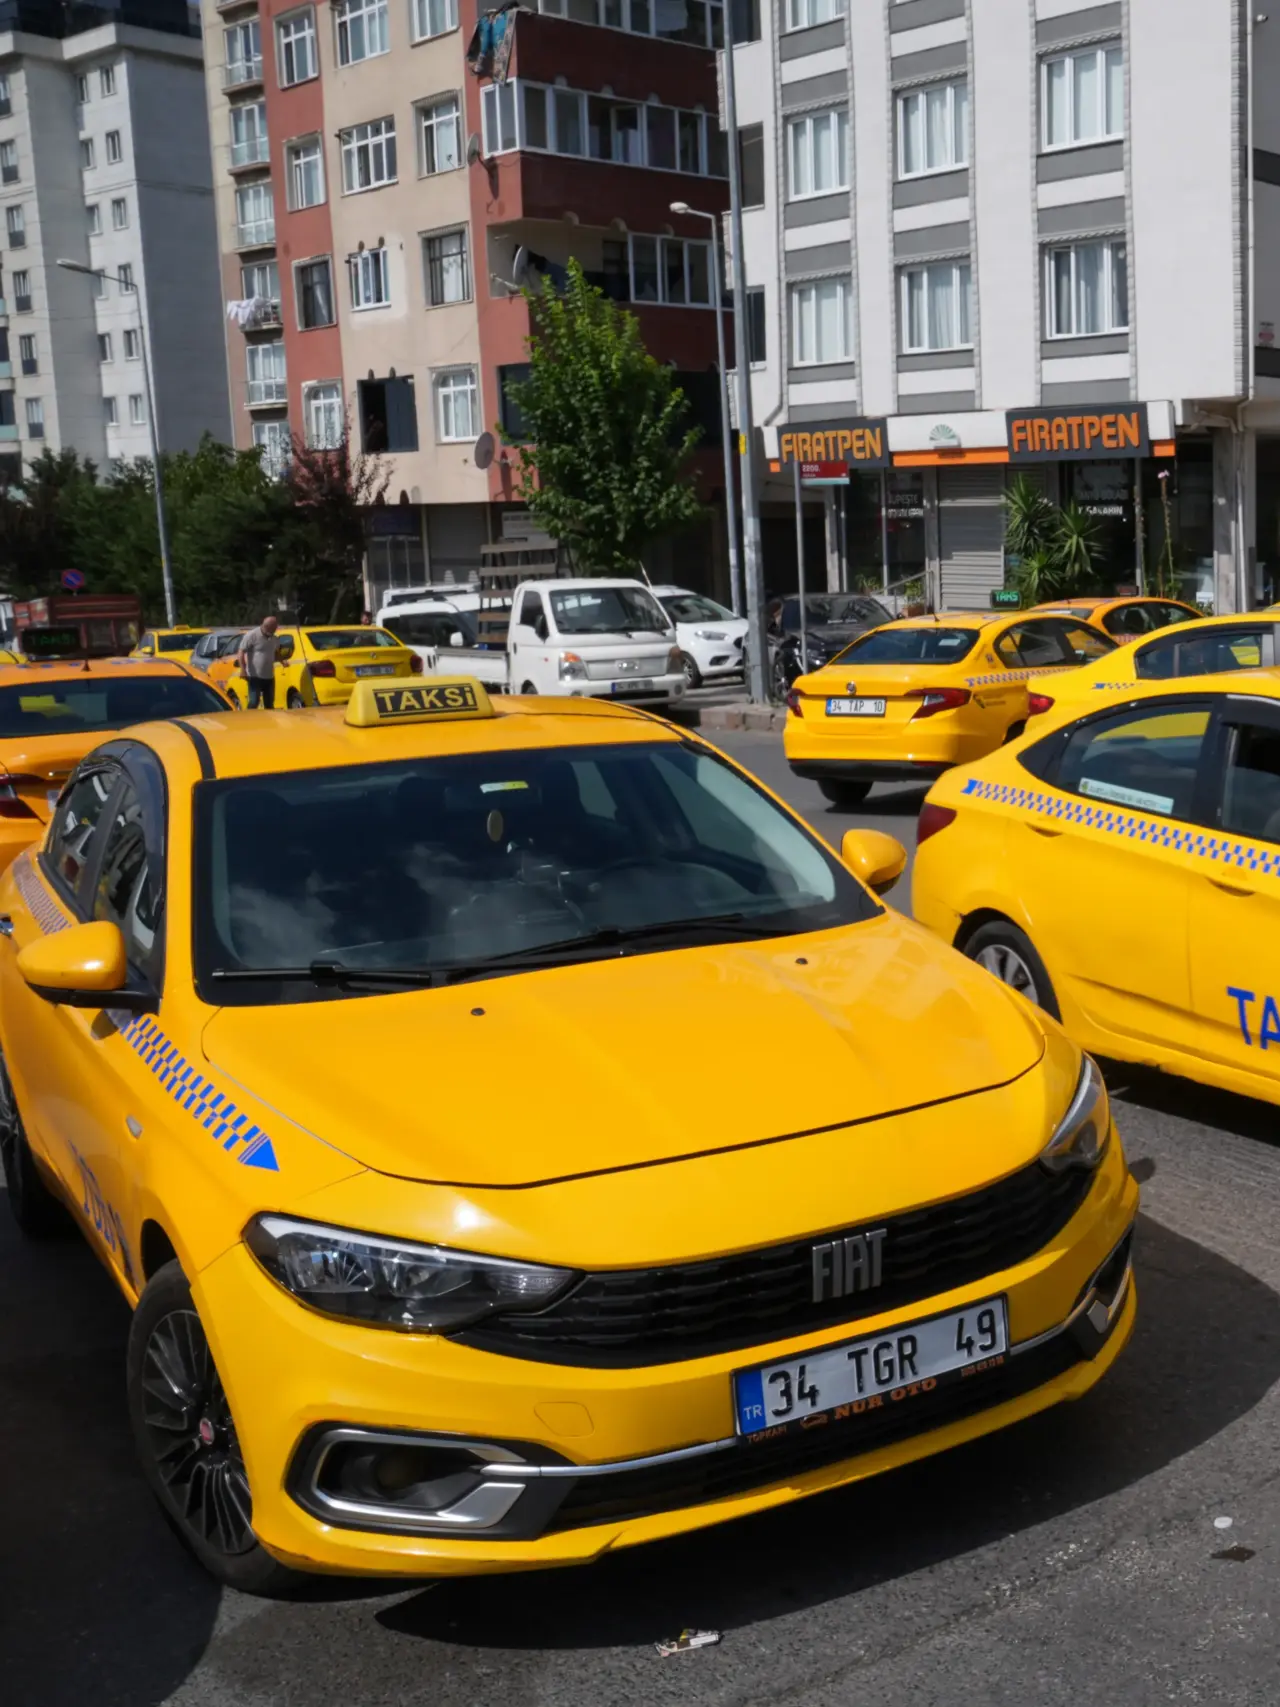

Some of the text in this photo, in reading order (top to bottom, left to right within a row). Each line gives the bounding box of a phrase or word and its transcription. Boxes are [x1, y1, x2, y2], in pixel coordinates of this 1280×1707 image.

[780, 427, 882, 464] FIRATPEN
[1011, 411, 1141, 453] FIRATPEN
[812, 1227, 888, 1303] FIAT
[743, 1403, 763, 1420] TR
[767, 1364, 820, 1418] 34
[847, 1333, 919, 1394] TGR
[955, 1308, 997, 1358] 49
[833, 1394, 884, 1421] NUR
[890, 1376, 938, 1402] OTO
